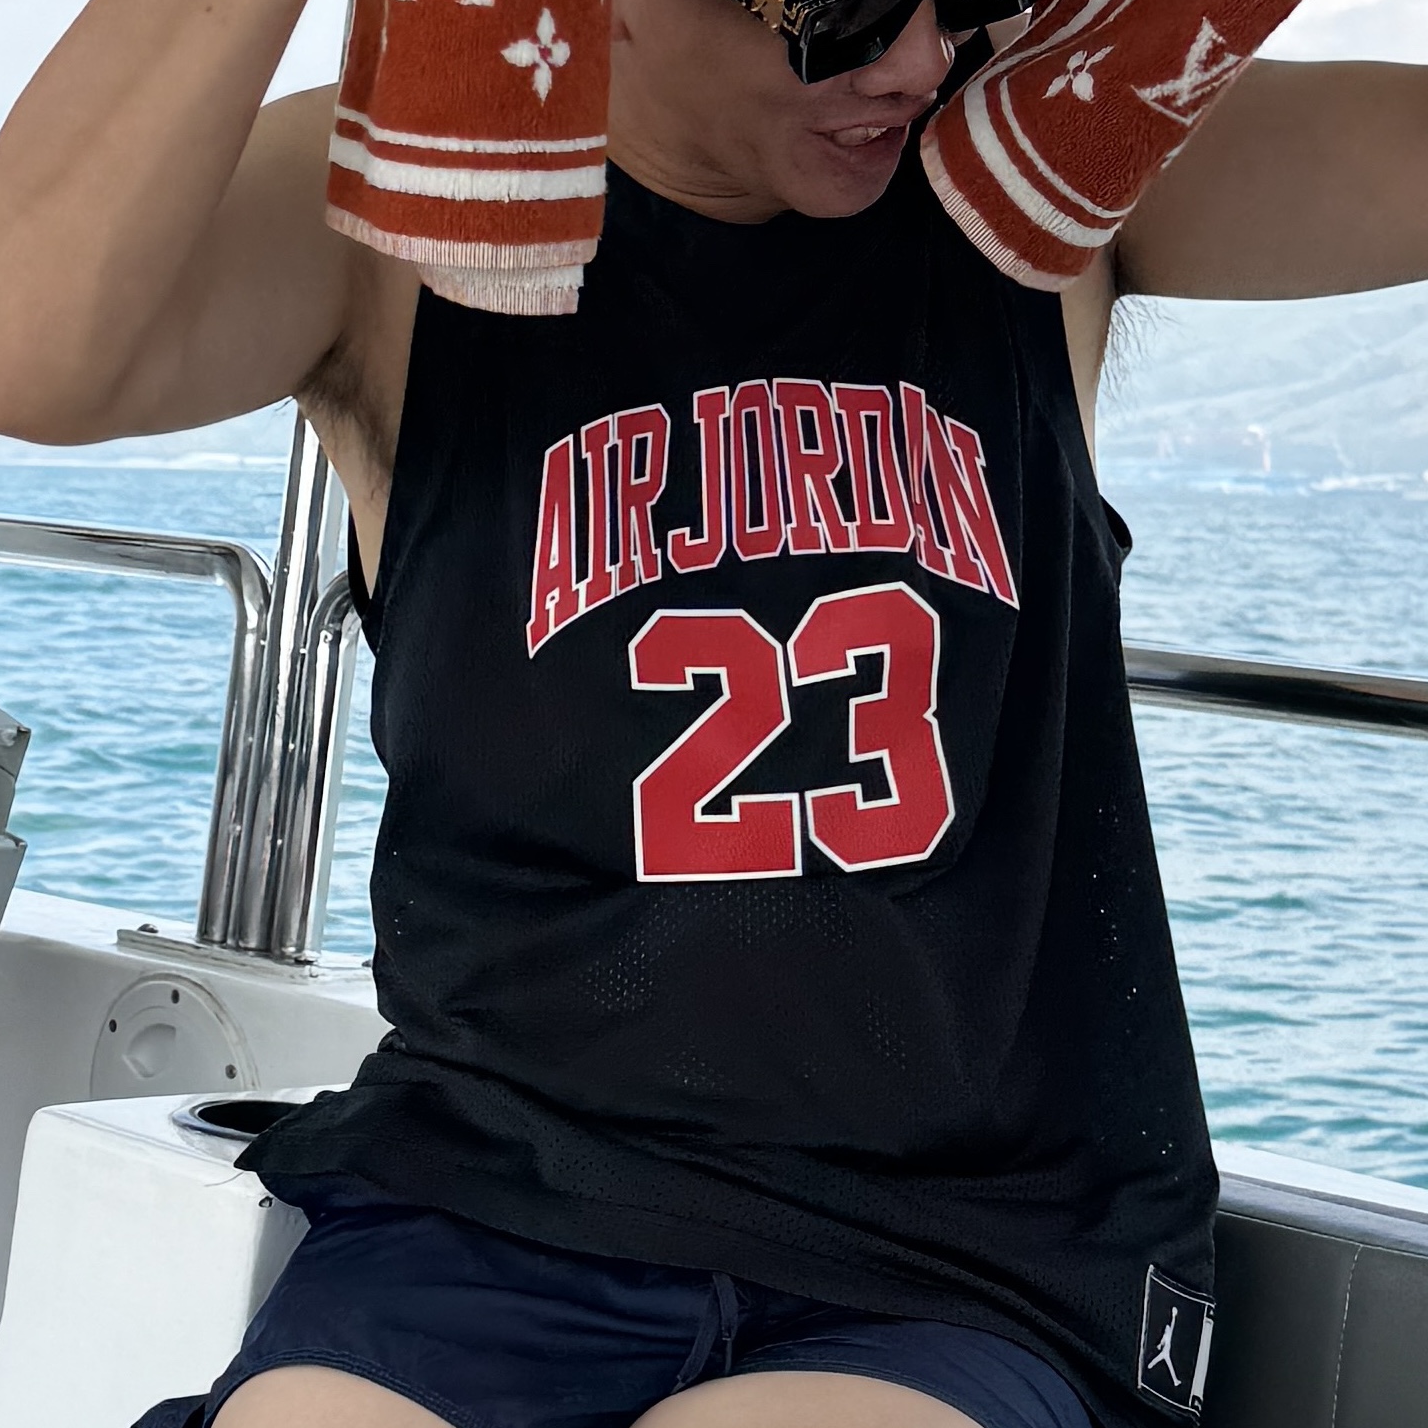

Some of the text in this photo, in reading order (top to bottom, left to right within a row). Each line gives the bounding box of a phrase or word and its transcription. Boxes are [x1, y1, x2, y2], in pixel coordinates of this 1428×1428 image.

[526, 377, 1020, 659] AIR JORDAN
[628, 581, 956, 882] 23
